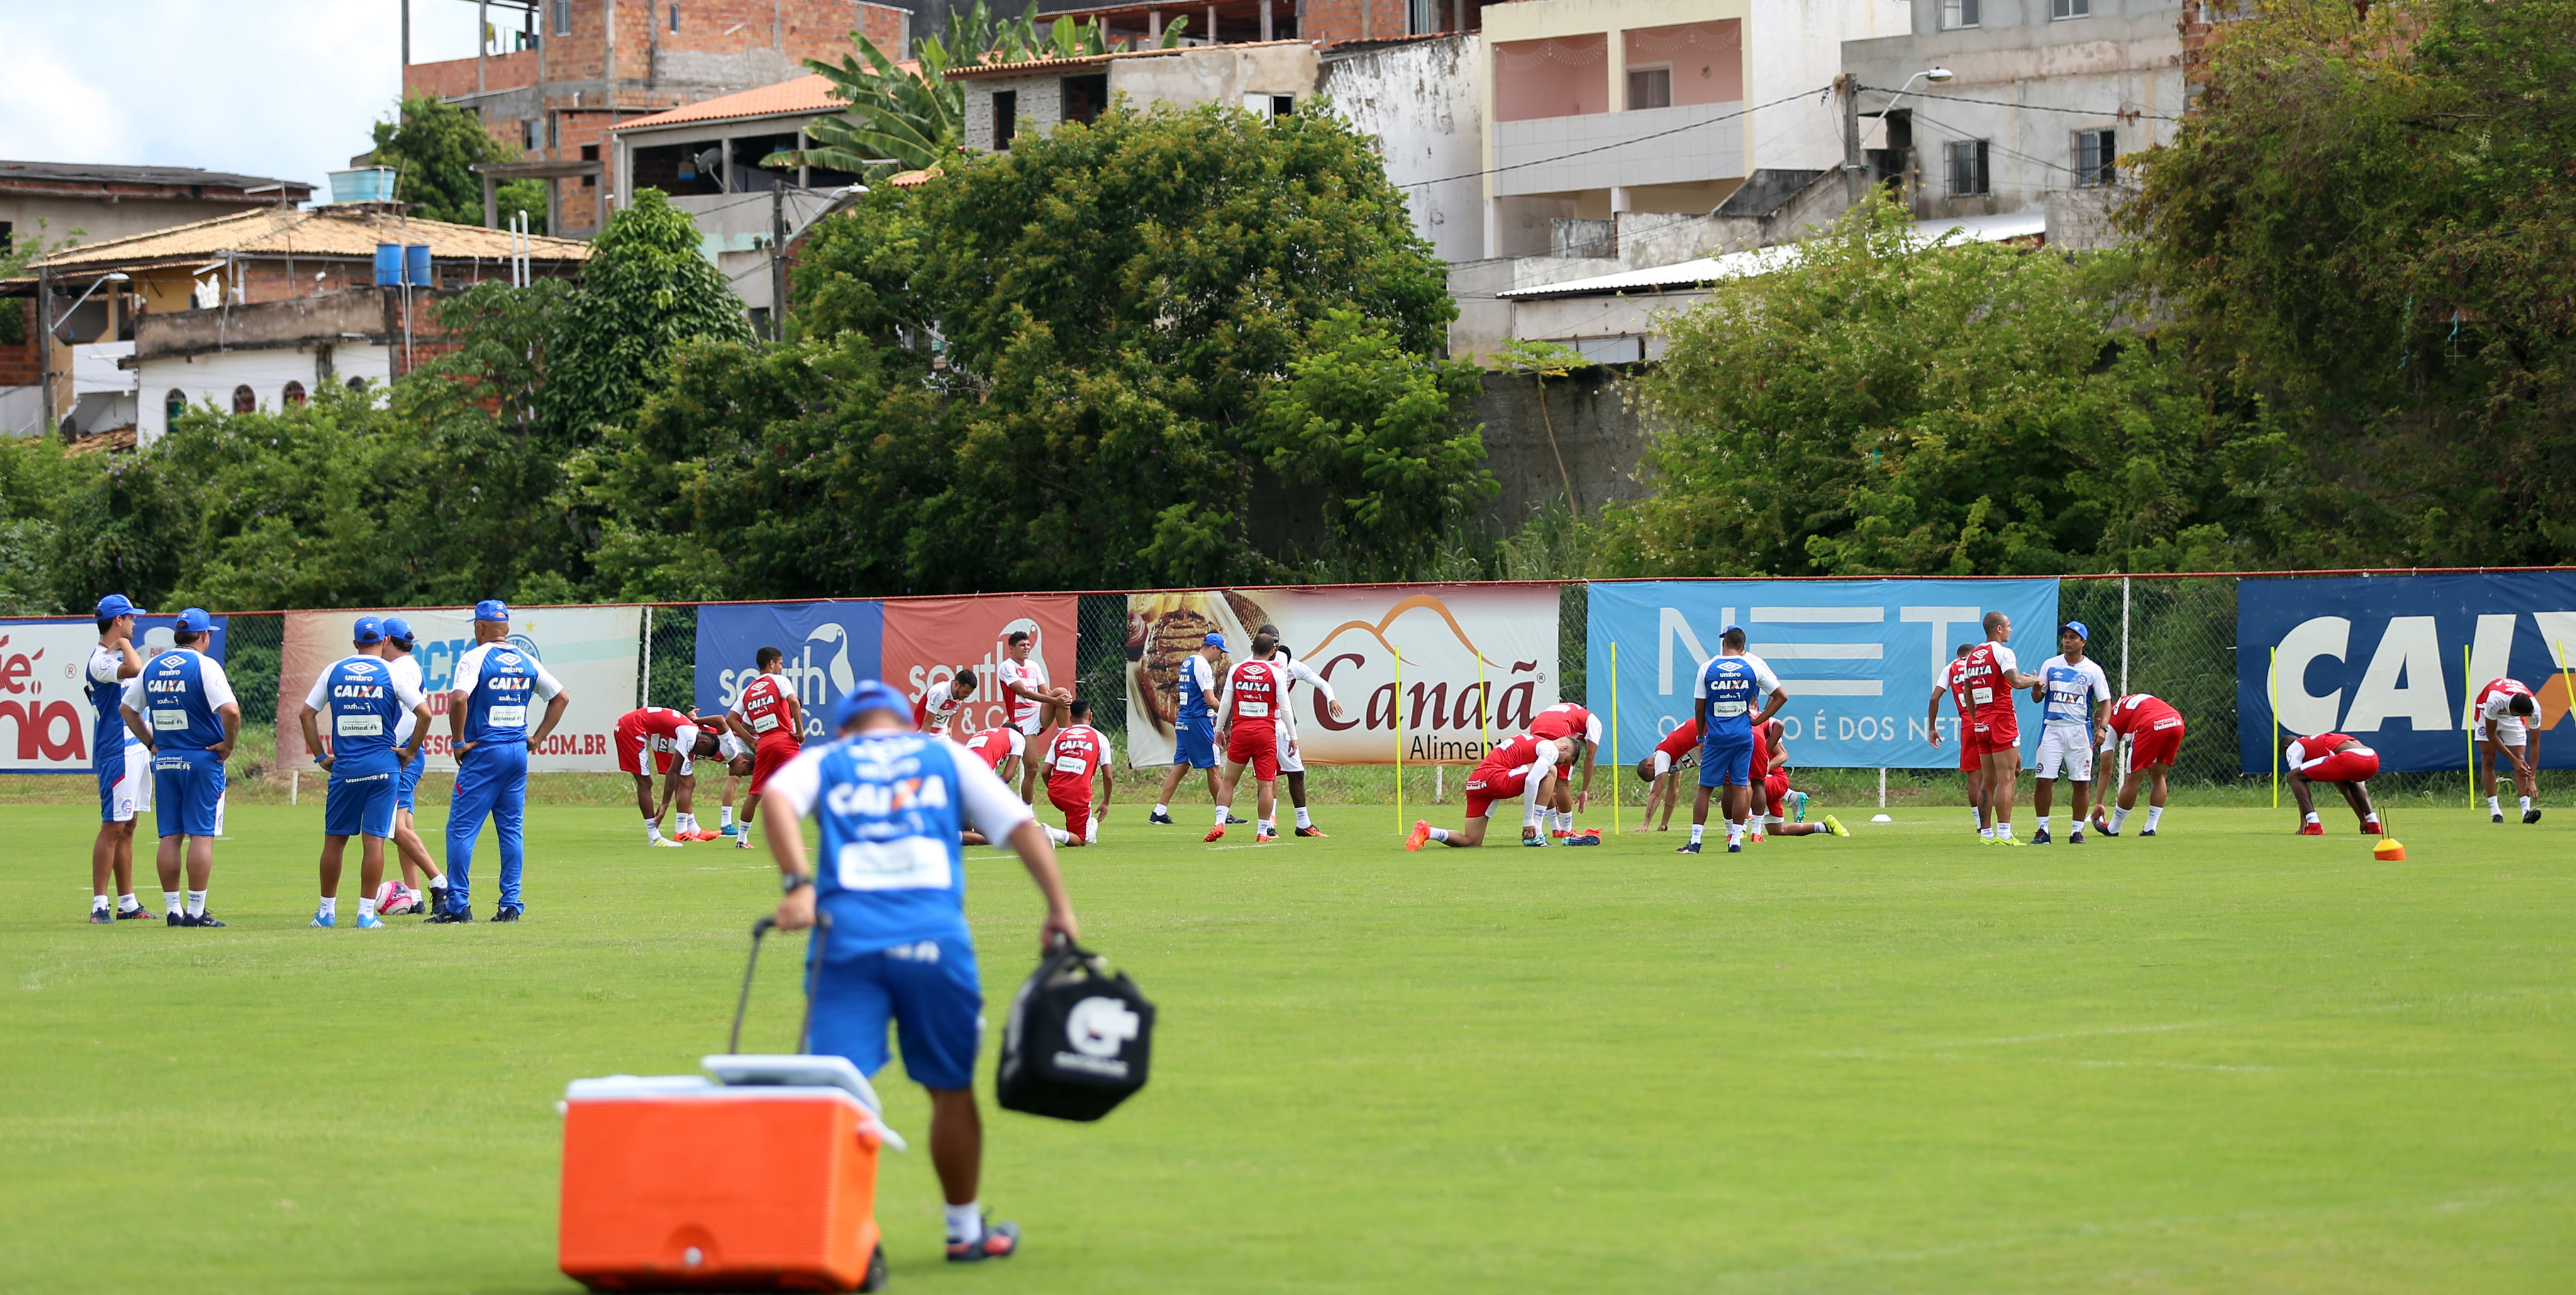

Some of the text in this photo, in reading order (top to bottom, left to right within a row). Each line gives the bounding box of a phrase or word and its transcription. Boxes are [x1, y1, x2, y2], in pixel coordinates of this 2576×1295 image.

[1658, 606, 1980, 696] NET
[345, 674, 374, 682] umbro
[719, 646, 826, 707] soth
[148, 680, 186, 692] CAIXA
[489, 677, 531, 689] CAIXA
[1235, 681, 1270, 692] CAIXA
[1711, 680, 1749, 690] CAIXA
[334, 685, 384, 699] CAIXA
[1313, 653, 1537, 730] Canaã
[748, 694, 775, 711] CAIXA
[1814, 708, 1826, 740] É
[1839, 716, 1894, 741] DOS
[1909, 716, 1962, 741] NET
[2153, 721, 2177, 731] Unimed
[1059, 740, 1093, 752] CAIXA
[1409, 735, 1502, 760] Alimen
[156, 762, 180, 770] Unimed
